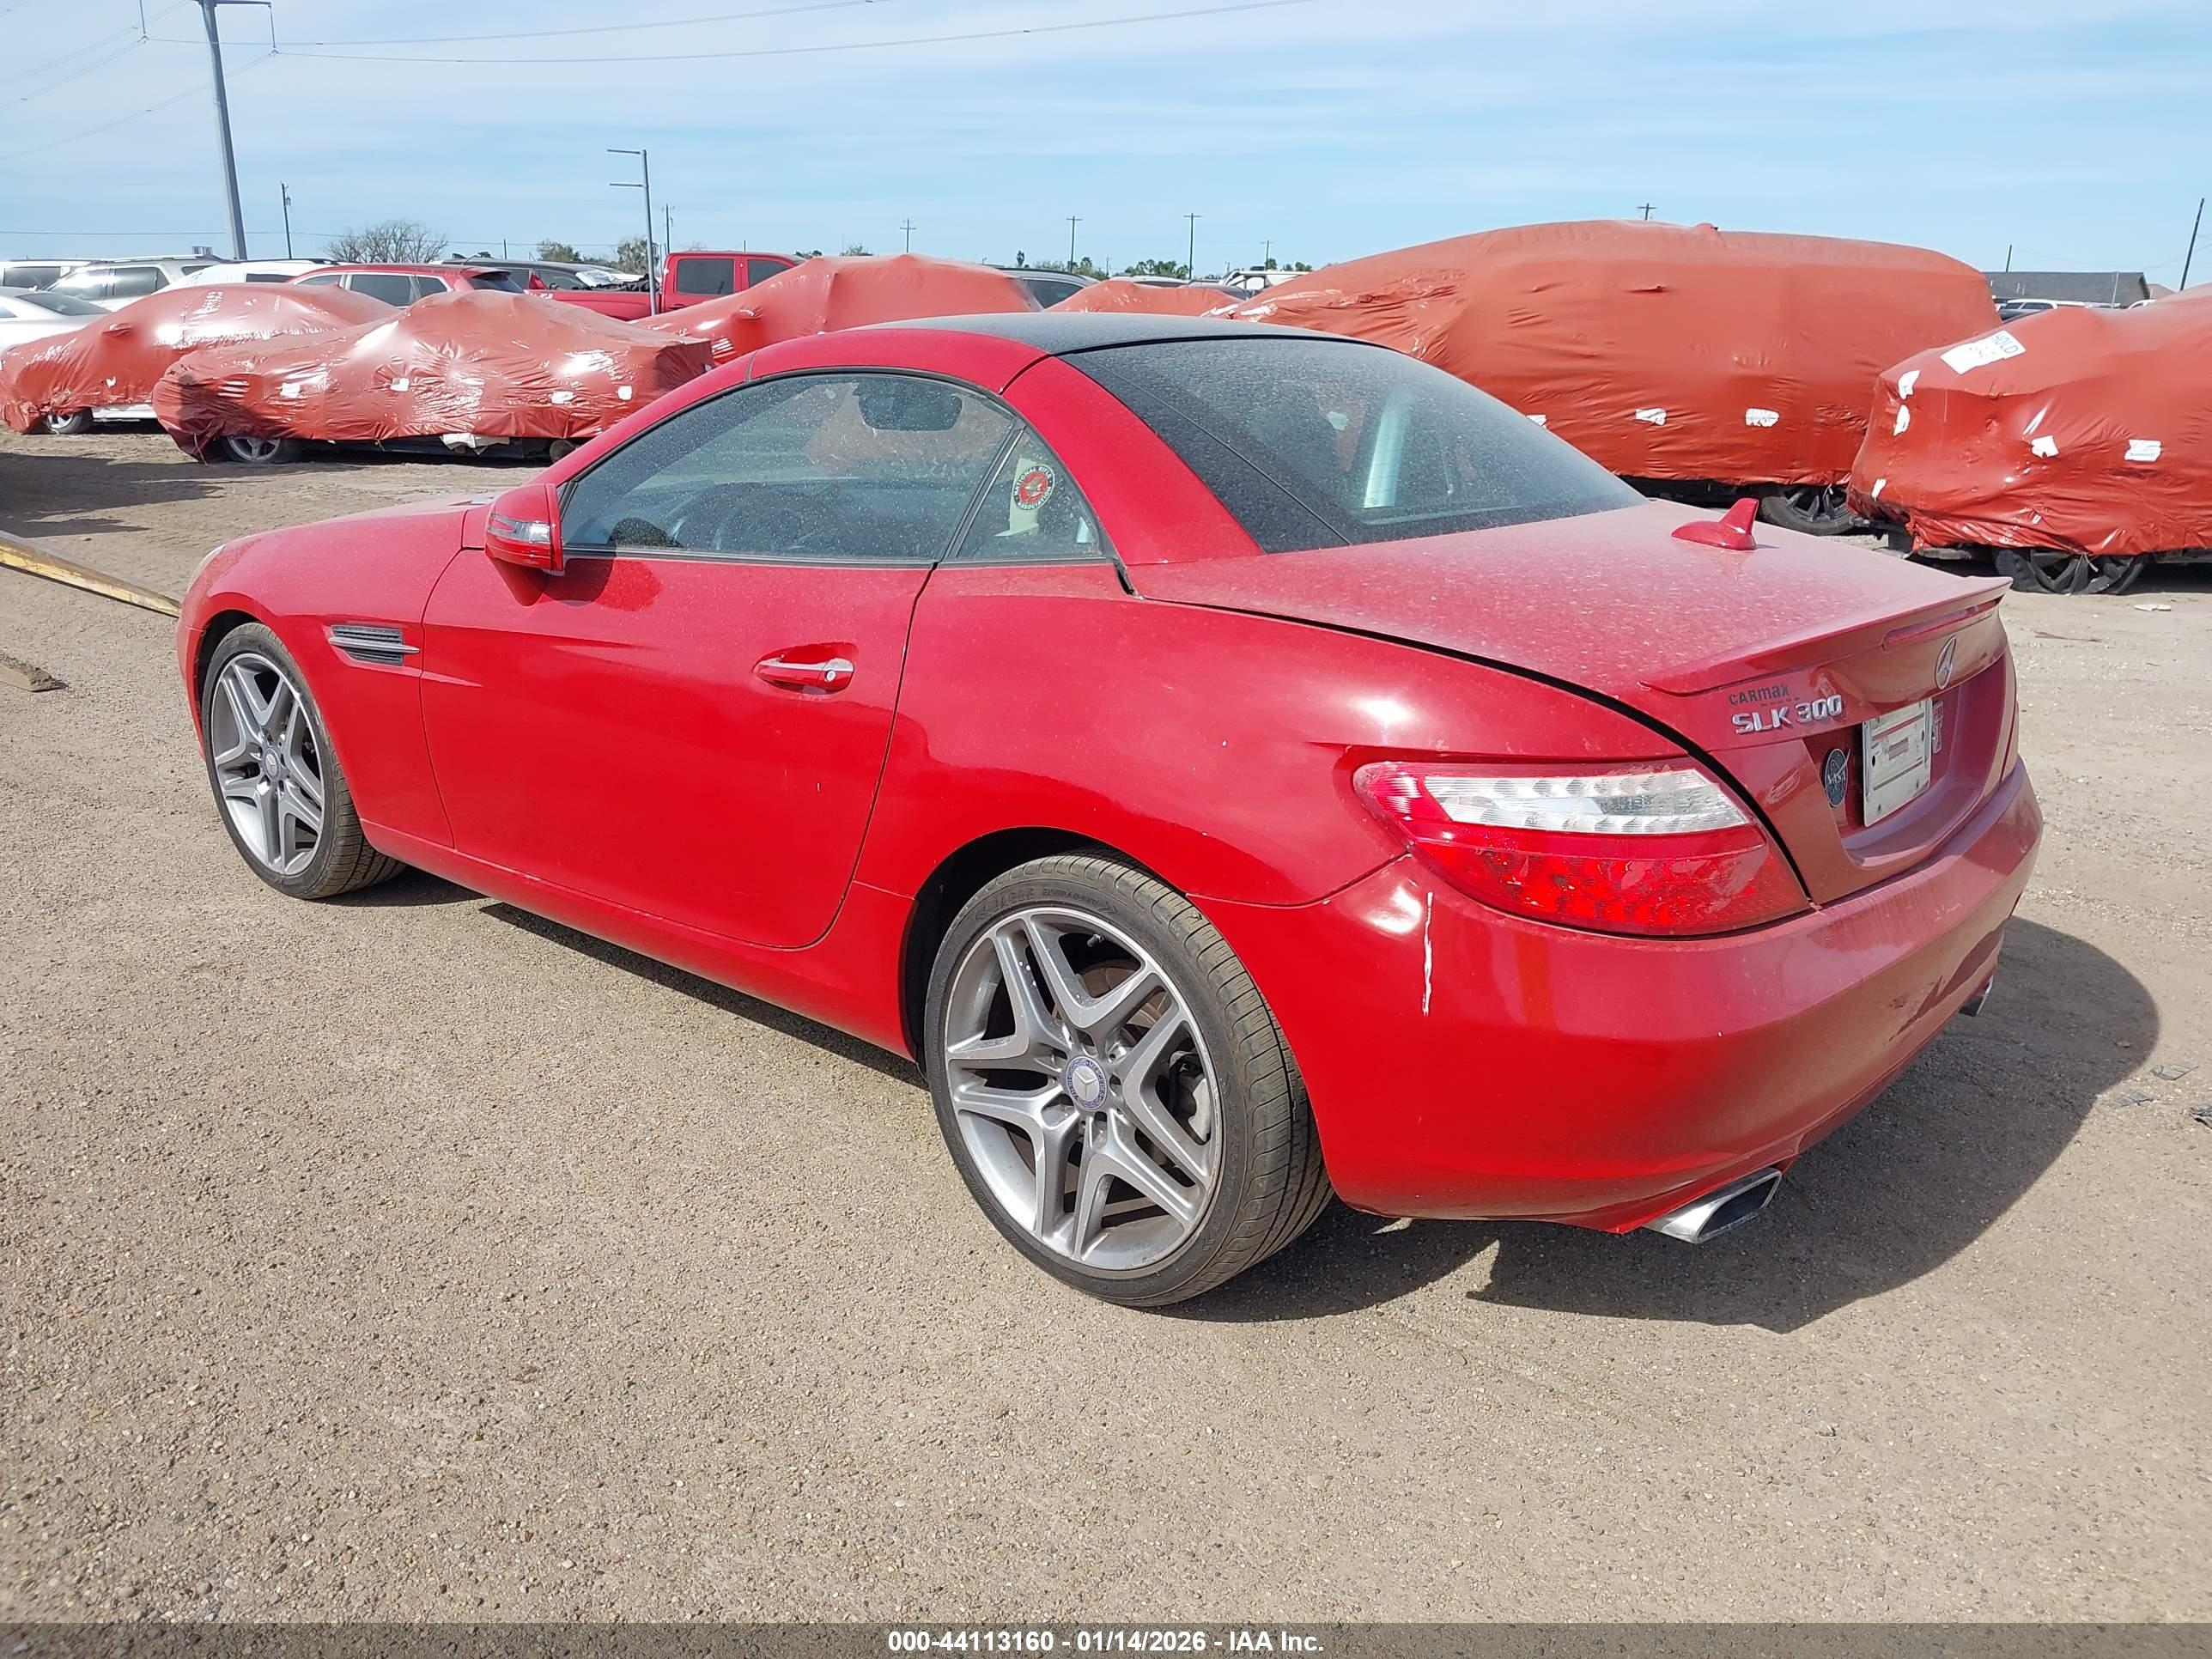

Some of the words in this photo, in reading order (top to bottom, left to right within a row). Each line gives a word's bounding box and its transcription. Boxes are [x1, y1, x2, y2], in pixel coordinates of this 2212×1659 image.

[1992, 334, 2019, 354] HOLD
[1014, 466, 1037, 495] NATIONAL
[1037, 466, 1053, 479] RIFLE
[1017, 487, 1052, 510] ASSOCIATION
[1732, 707, 1792, 734] SLK
[1795, 695, 1843, 723] 300
